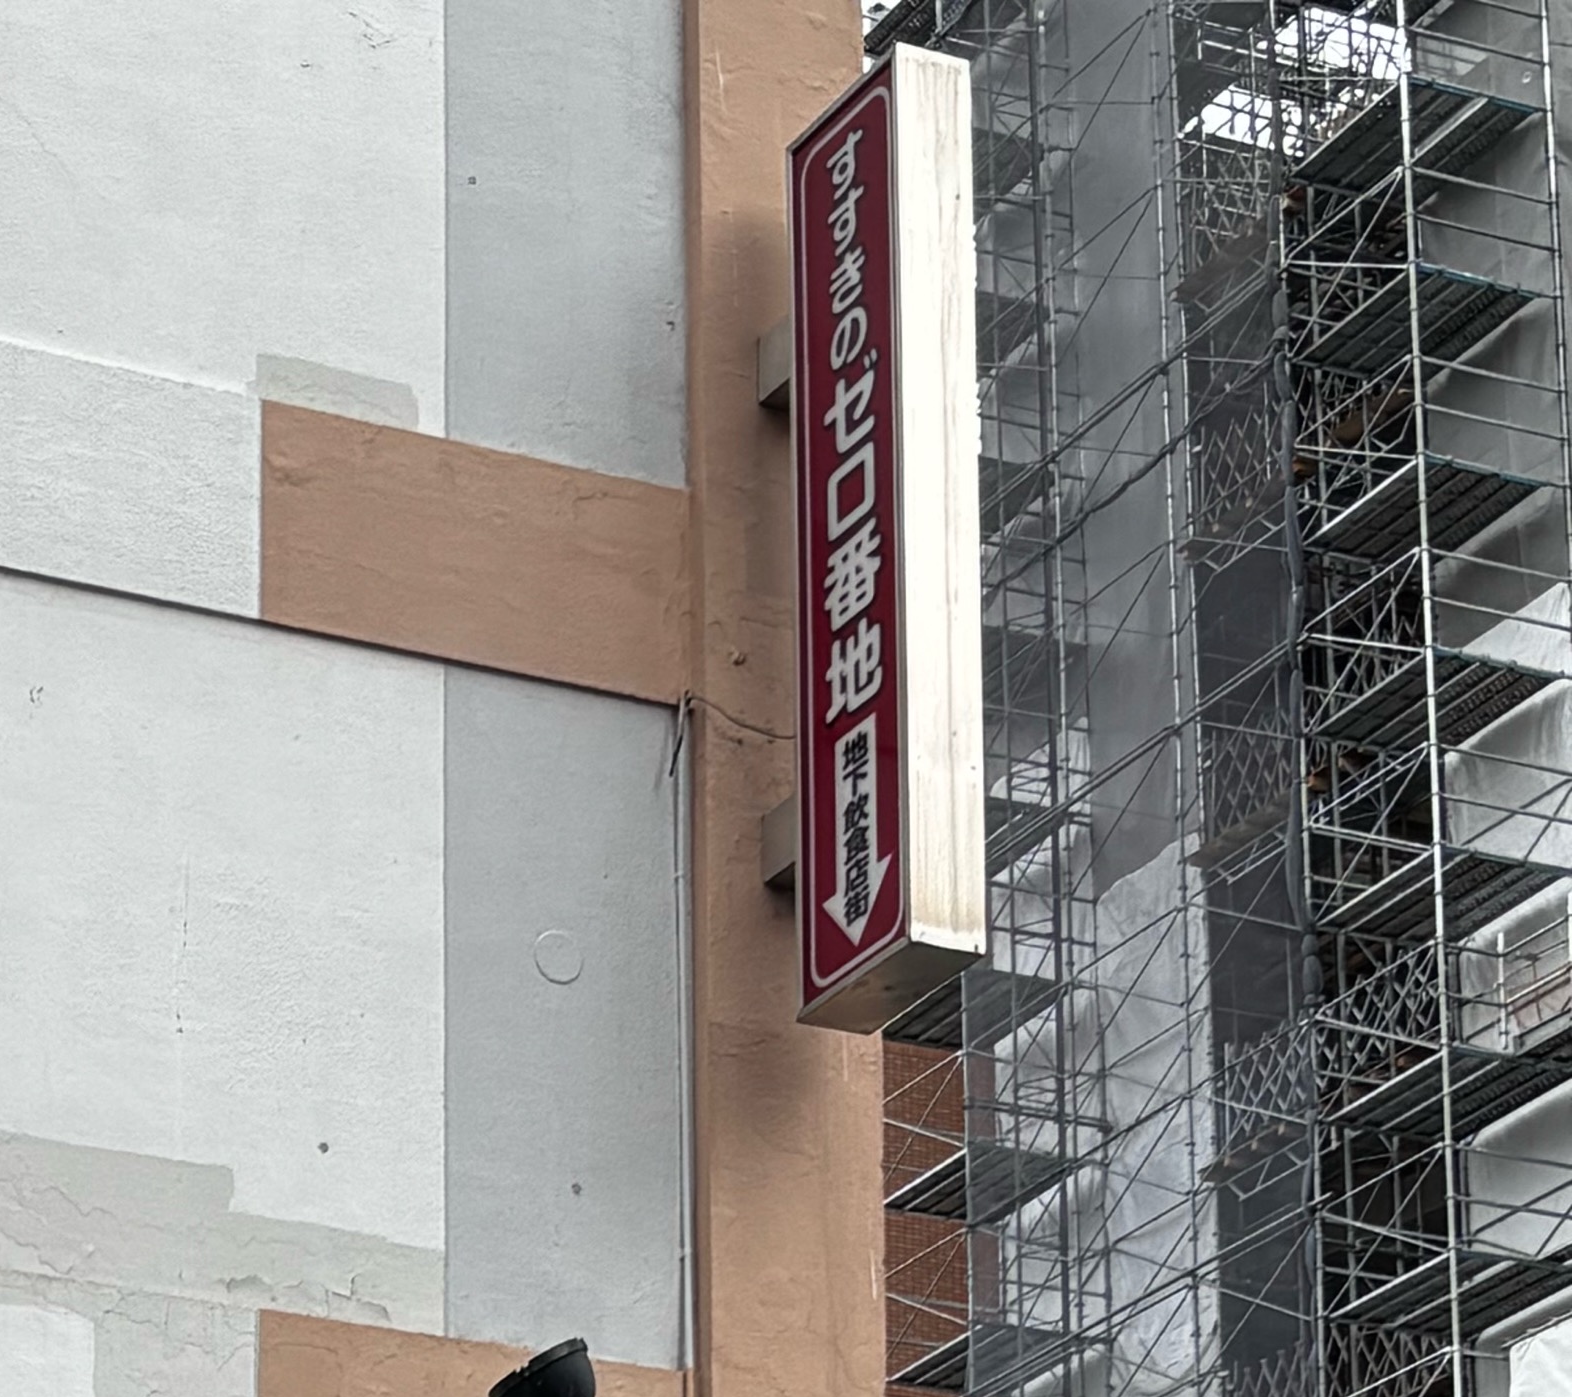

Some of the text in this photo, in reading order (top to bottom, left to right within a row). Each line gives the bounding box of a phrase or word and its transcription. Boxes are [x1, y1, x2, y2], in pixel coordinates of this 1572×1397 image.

[824, 127, 883, 724] すすきのゼロ番地
[841, 729, 871, 927] 地下飲食店街
